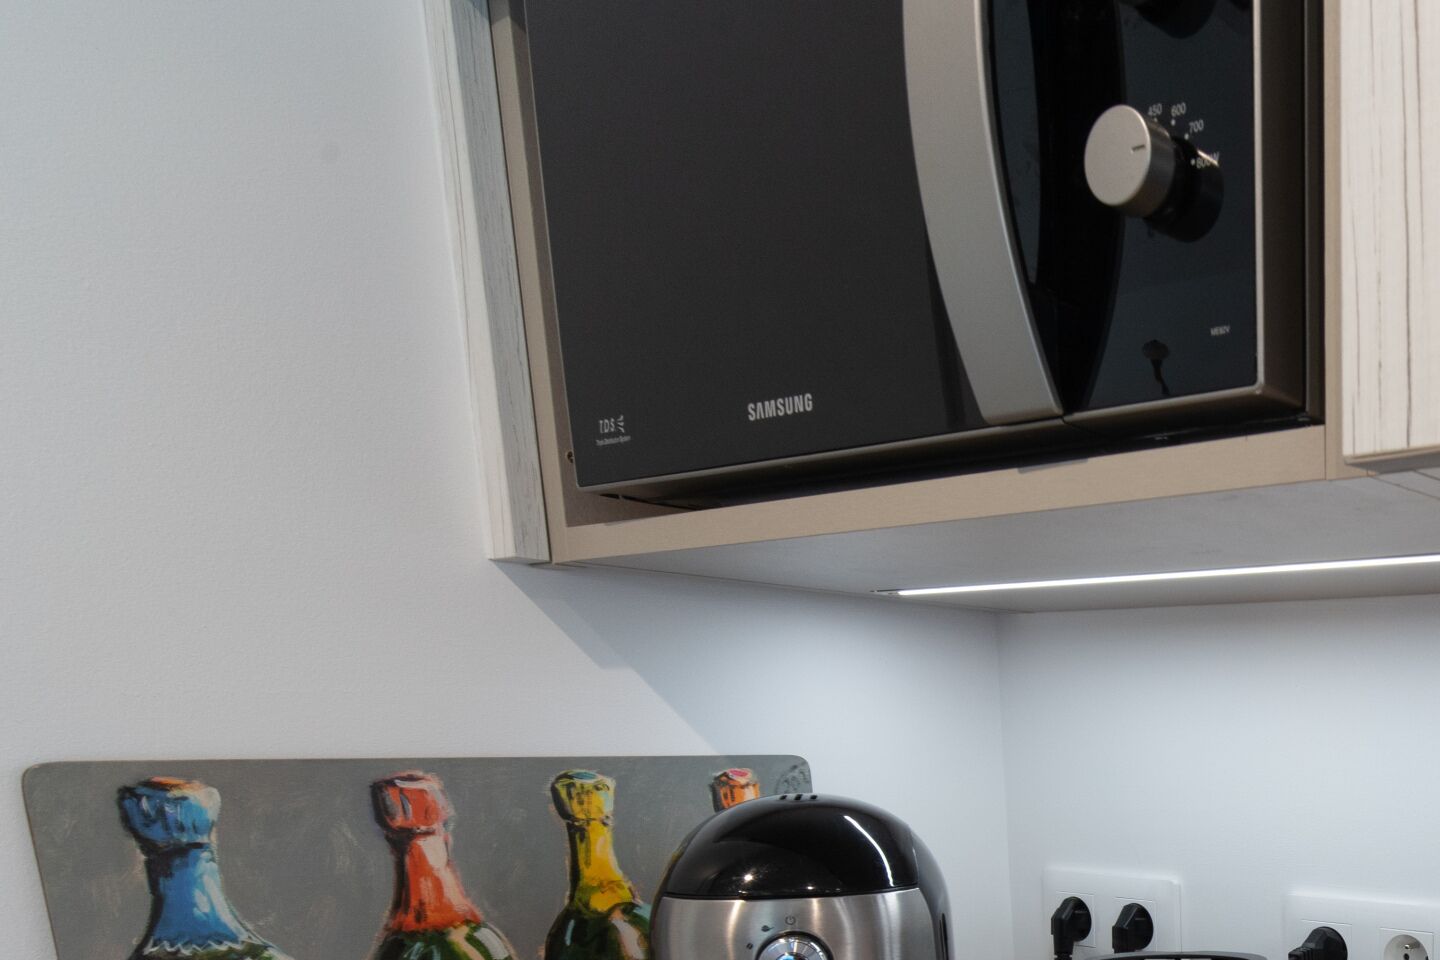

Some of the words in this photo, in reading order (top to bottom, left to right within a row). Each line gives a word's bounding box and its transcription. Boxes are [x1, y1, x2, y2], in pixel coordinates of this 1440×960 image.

[1170, 102, 1187, 117] 600
[1188, 119, 1205, 133] 700
[747, 392, 813, 421] SAMSUNG
